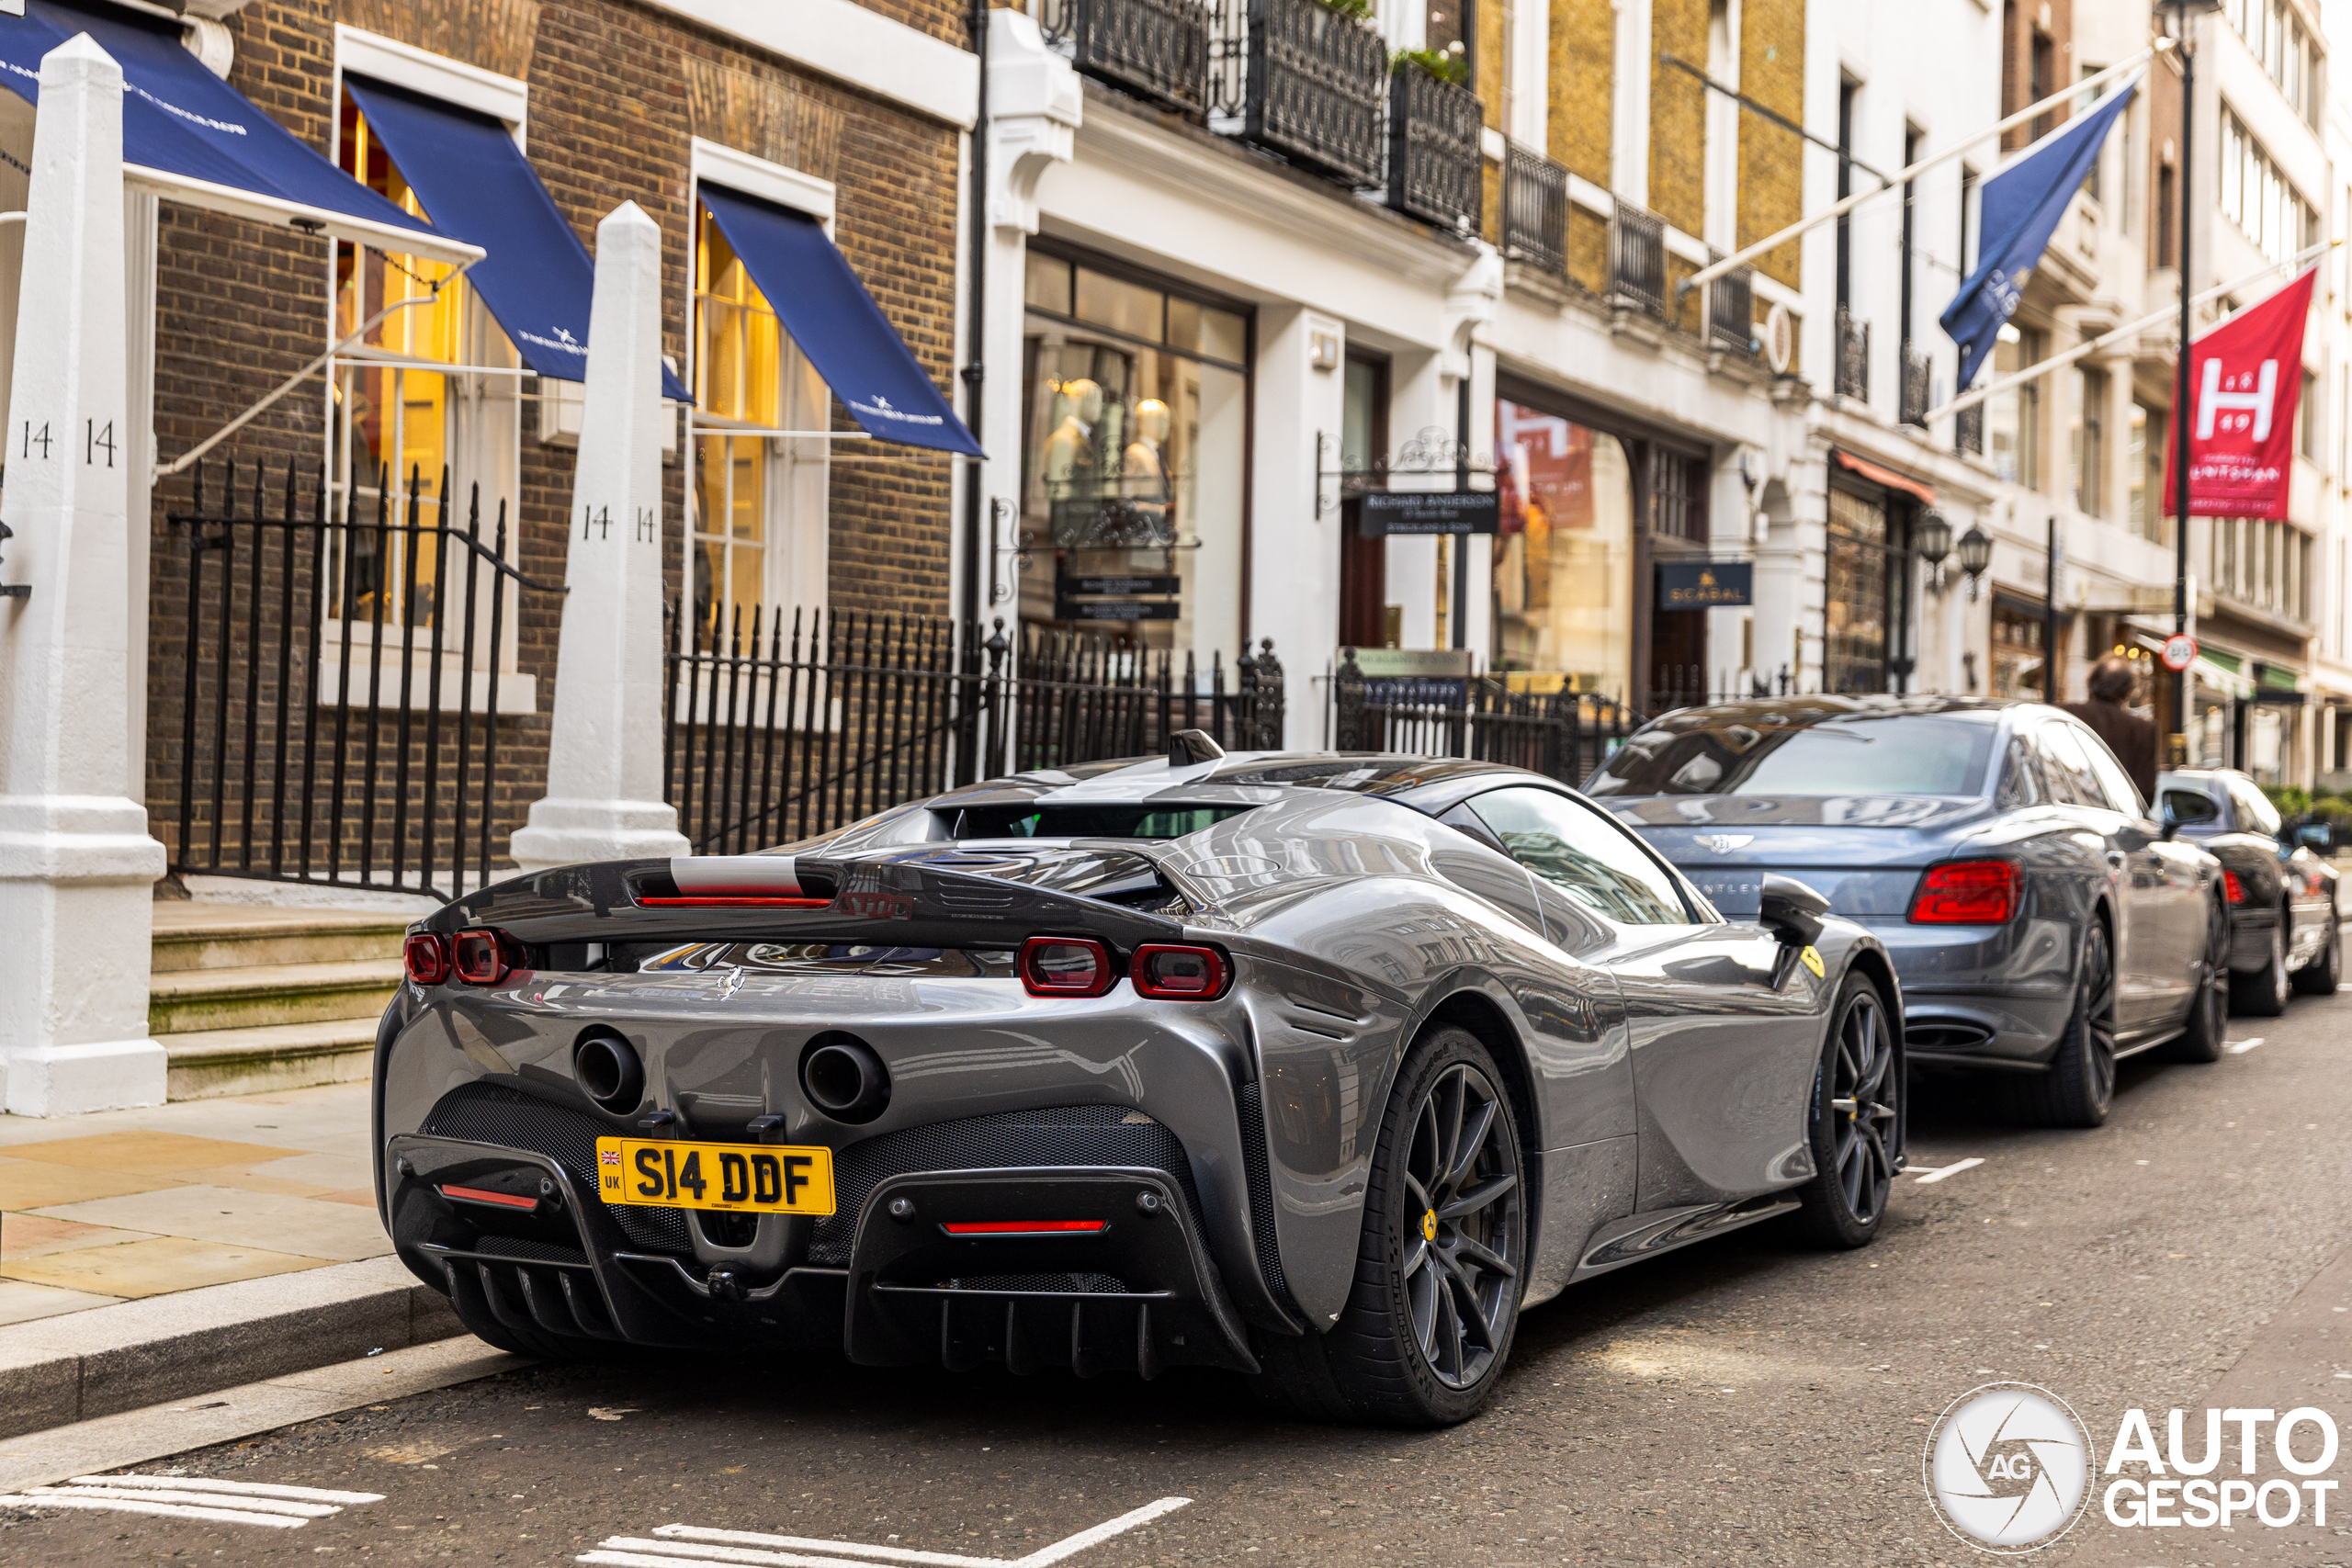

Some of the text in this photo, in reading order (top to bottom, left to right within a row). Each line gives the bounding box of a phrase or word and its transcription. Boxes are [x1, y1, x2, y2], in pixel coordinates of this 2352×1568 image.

[2196, 357, 2278, 442] H
[23, 420, 53, 459] 14
[86, 417, 117, 468] 14
[2189, 464, 2280, 482] UNTSMAN
[1367, 493, 1496, 509] RICHARD ANDERSON
[583, 503, 615, 542] 14
[637, 505, 657, 544] 14
[1668, 588, 1746, 604] SCABAL
[1693, 884, 1762, 895] ENTLEY
[605, 1175, 620, 1190] UK
[635, 1148, 813, 1204] S14 DDF
[1391, 1271, 1414, 1357] MICHELIN
